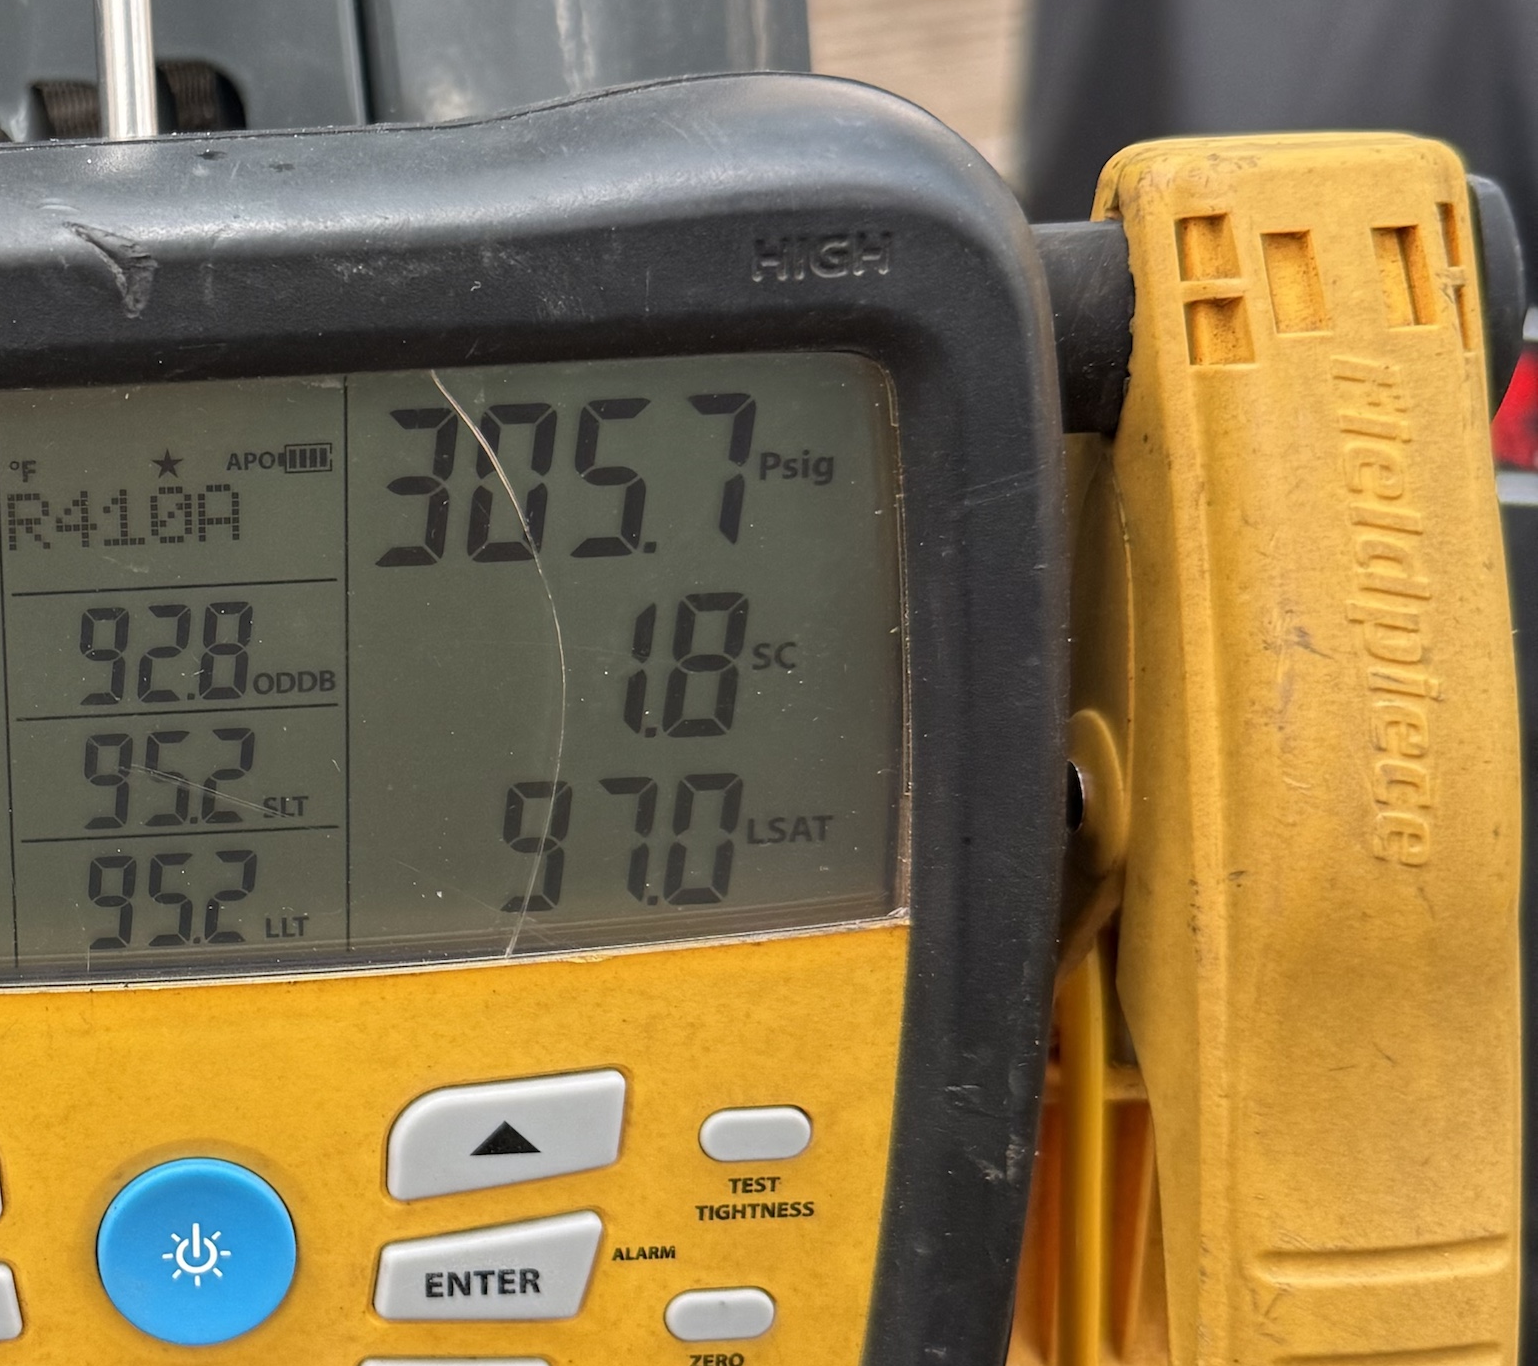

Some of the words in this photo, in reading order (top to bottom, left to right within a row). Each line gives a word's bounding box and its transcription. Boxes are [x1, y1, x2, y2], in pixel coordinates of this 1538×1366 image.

[752, 232, 891, 282] HIGH
[226, 451, 276, 472] APO
[375, 393, 757, 567] 305.7
[759, 451, 835, 486] Psig
[7, 484, 240, 551] R410A
[1330, 354, 1444, 868] Fieldpiece
[80, 601, 253, 706] 92.8
[253, 670, 336, 696] ODDB
[623, 592, 749, 739] 1.8
[752, 642, 797, 671] SC
[83, 728, 255, 830] 95.2
[263, 796, 309, 818] SLT
[500, 773, 744, 913] 97.0
[746, 816, 833, 845] LSAT
[88, 849, 258, 950] 95.2
[265, 916, 309, 938] LLT
[695, 1200, 814, 1221] TIGHTNESS
[728, 1176, 781, 1194] TEST
[424, 1267, 541, 1298] ENTER
[612, 1245, 676, 1262] ALARM
